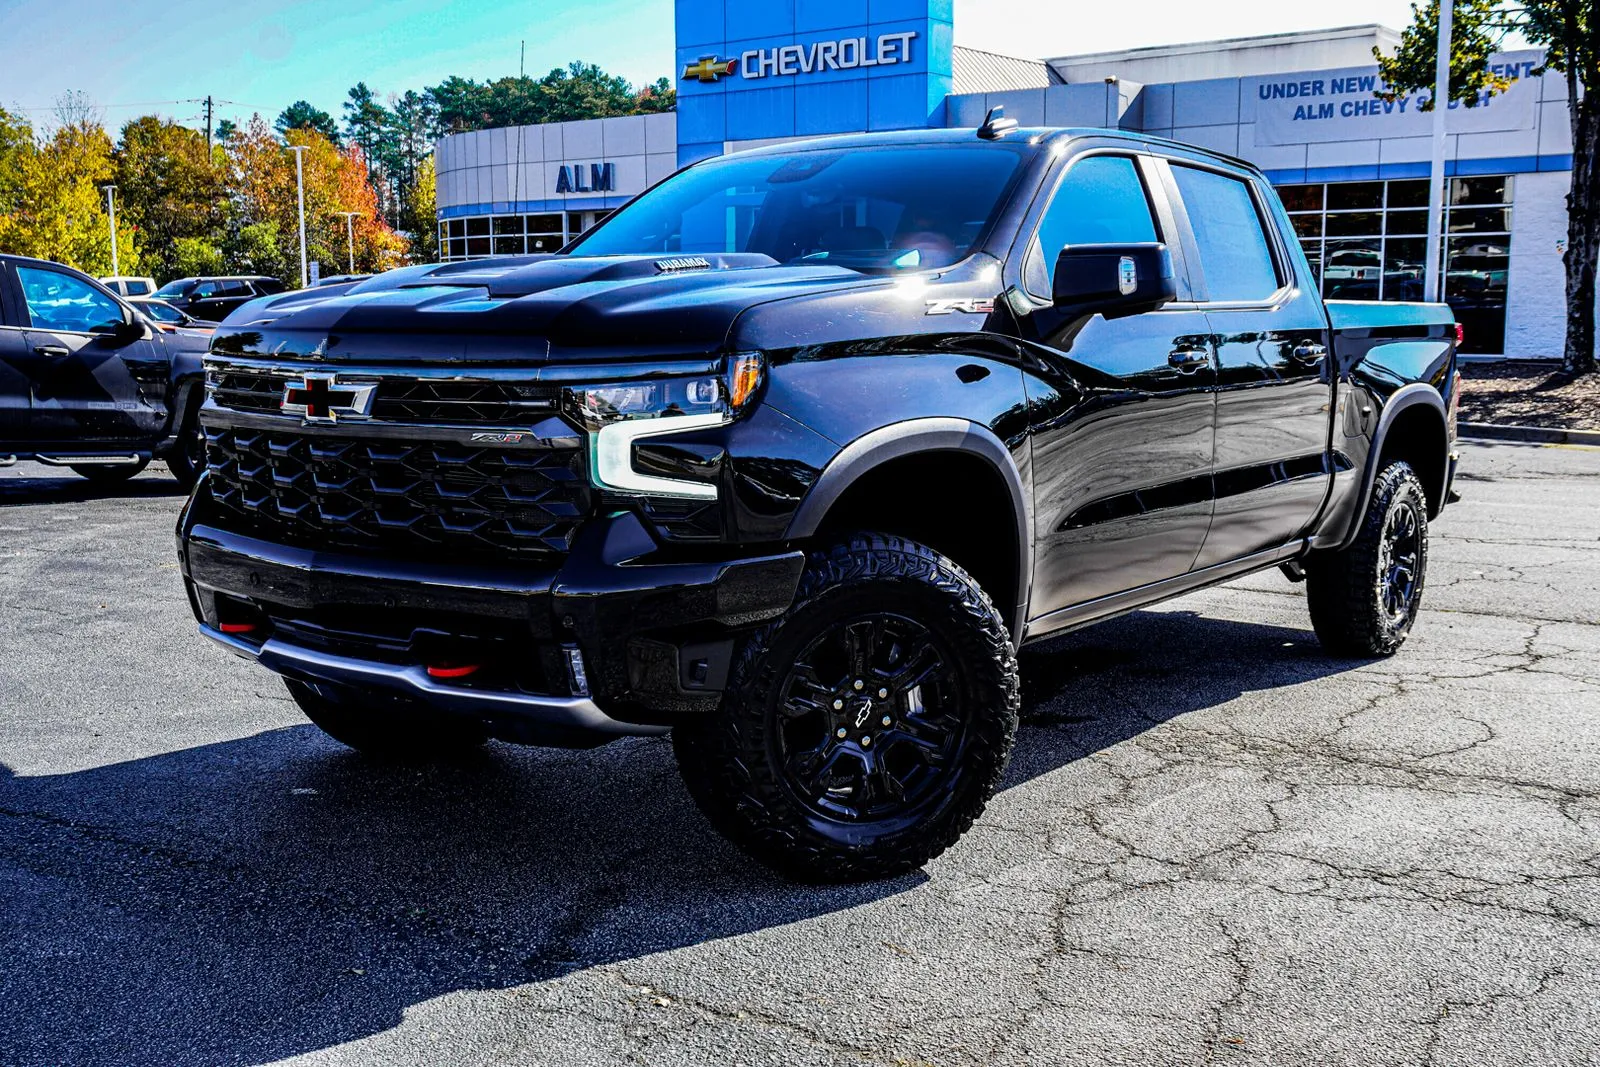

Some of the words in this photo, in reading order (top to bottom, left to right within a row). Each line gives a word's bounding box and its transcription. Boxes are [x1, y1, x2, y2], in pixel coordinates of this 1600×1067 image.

[741, 31, 916, 79] CHEVROLET
[1259, 80, 1325, 100] UNDER
[1331, 75, 1376, 95] NEW
[1293, 102, 1335, 121] ALM
[1341, 96, 1410, 117] CHEVY
[555, 162, 615, 194] ALM
[656, 257, 711, 271] DURAMAX
[925, 297, 995, 316] ZR2
[471, 432, 523, 443] ZR2
